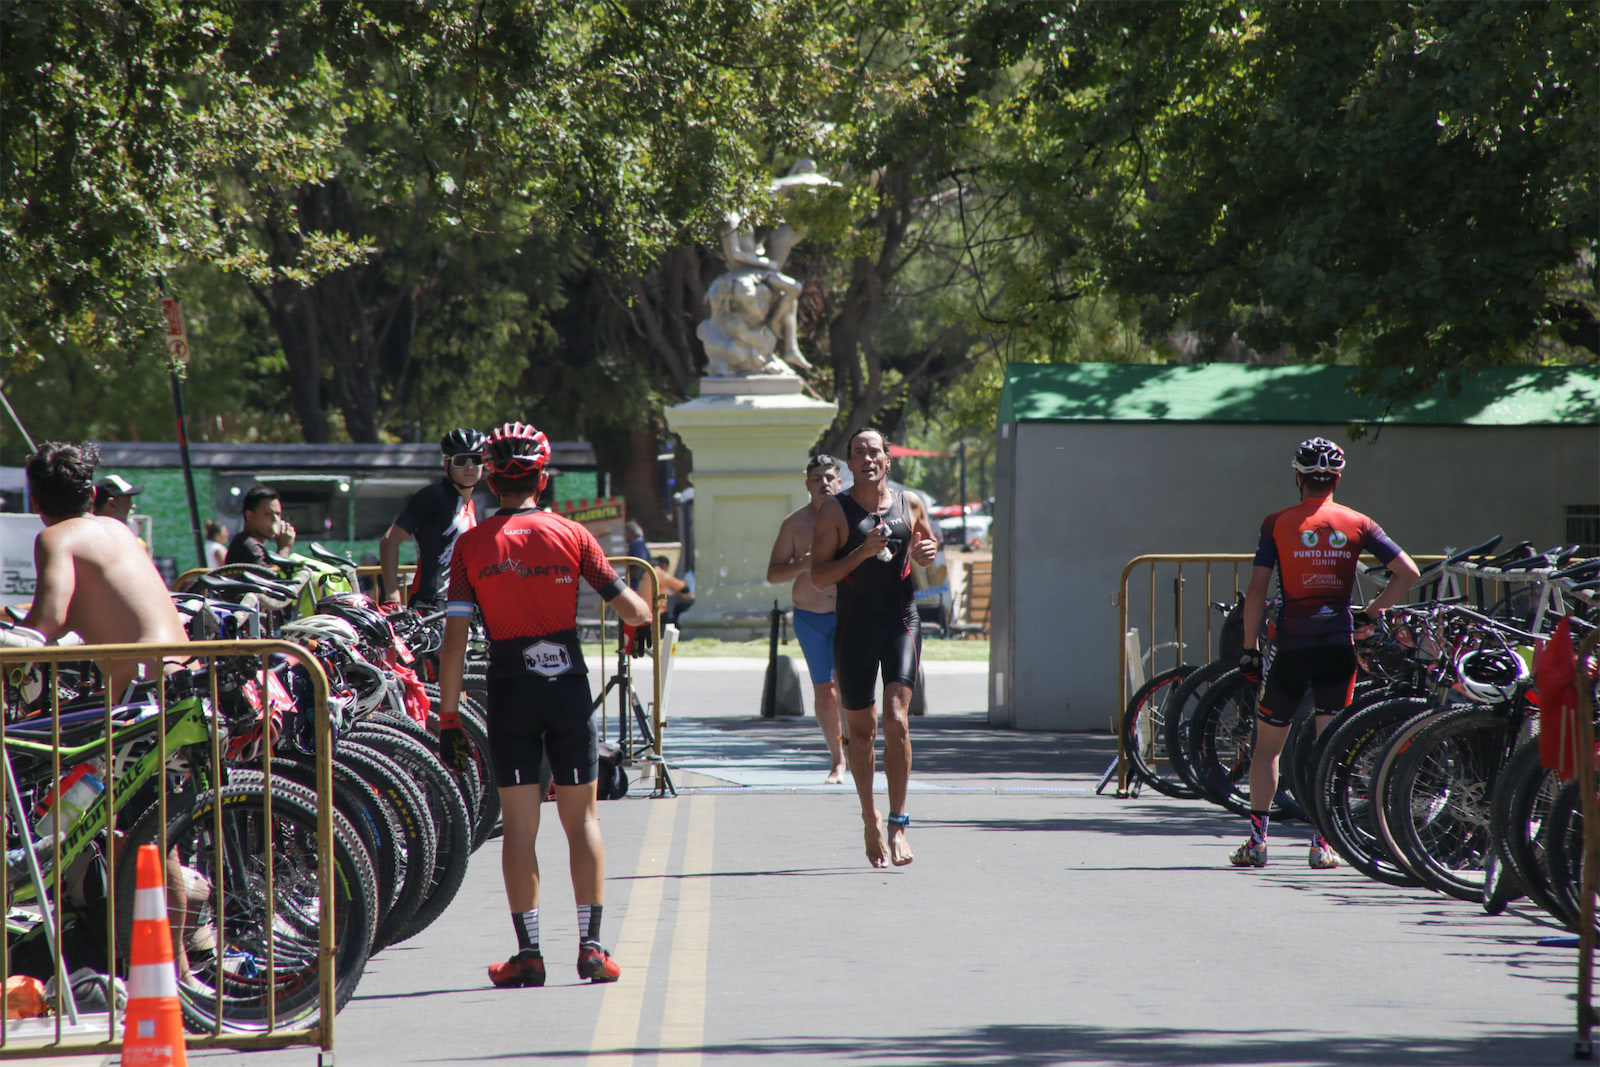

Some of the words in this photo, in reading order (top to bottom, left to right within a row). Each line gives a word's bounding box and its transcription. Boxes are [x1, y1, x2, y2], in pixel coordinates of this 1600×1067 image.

[890, 517, 903, 525] TYR
[1293, 550, 1322, 558] PUNTO
[1323, 550, 1352, 559] LIMPIO
[192, 795, 248, 821] MAXIS
[387, 789, 417, 839] MAXXIS
